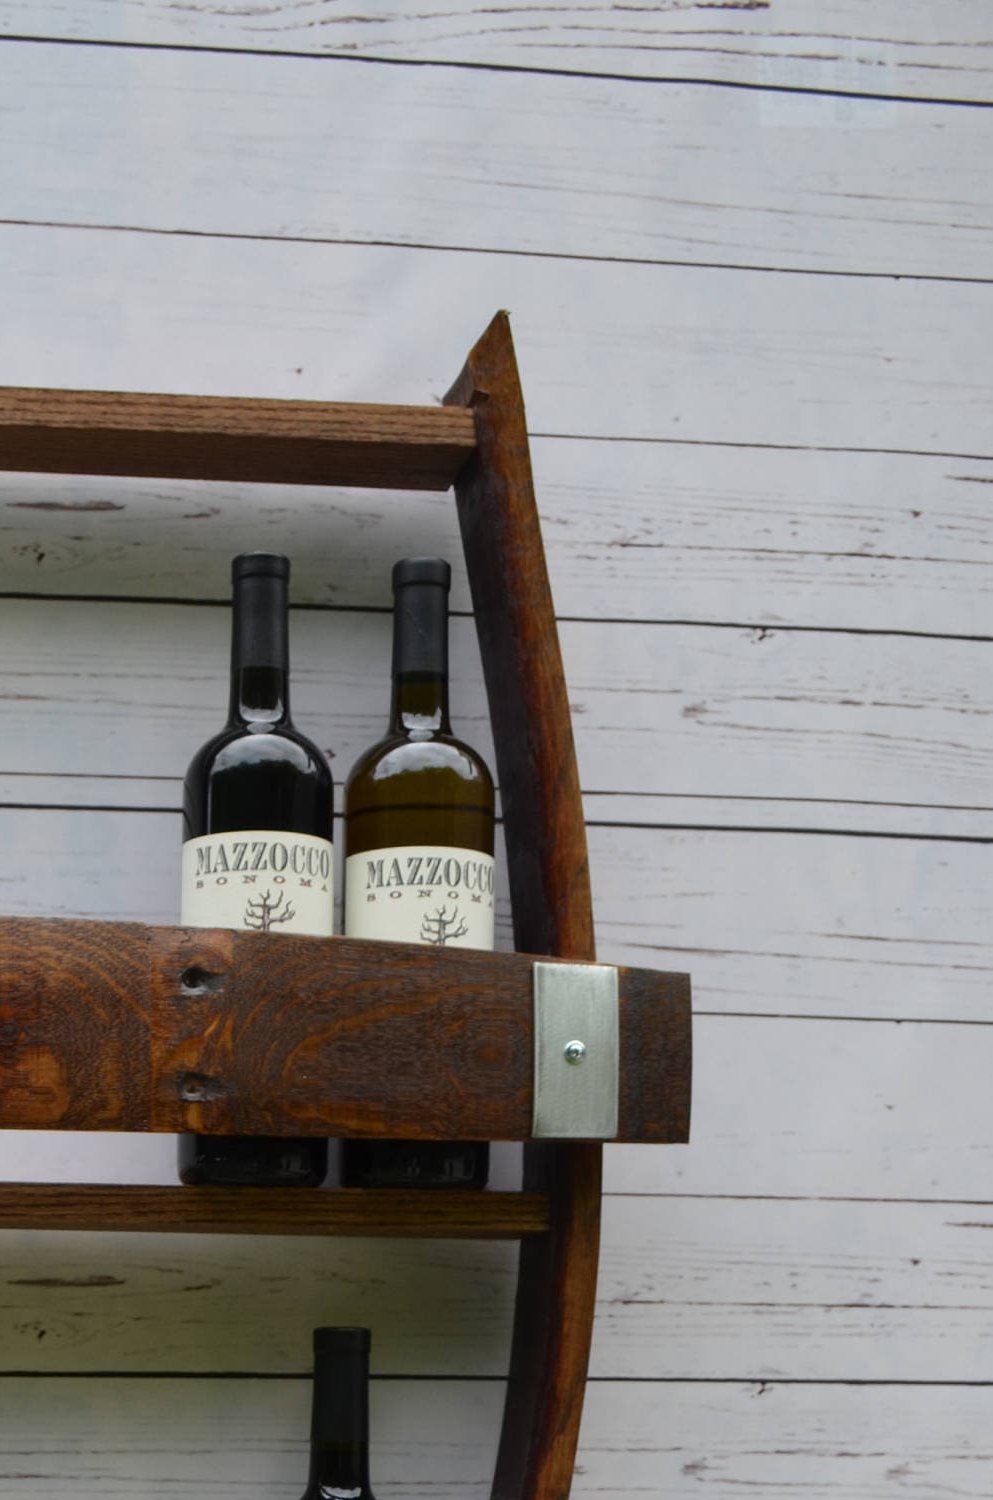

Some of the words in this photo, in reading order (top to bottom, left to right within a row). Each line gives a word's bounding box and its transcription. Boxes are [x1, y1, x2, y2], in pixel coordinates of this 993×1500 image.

[196, 842, 330, 880] MAZZOCCO
[366, 857, 494, 895] MAZZOCCO
[196, 875, 328, 892] SONOMA
